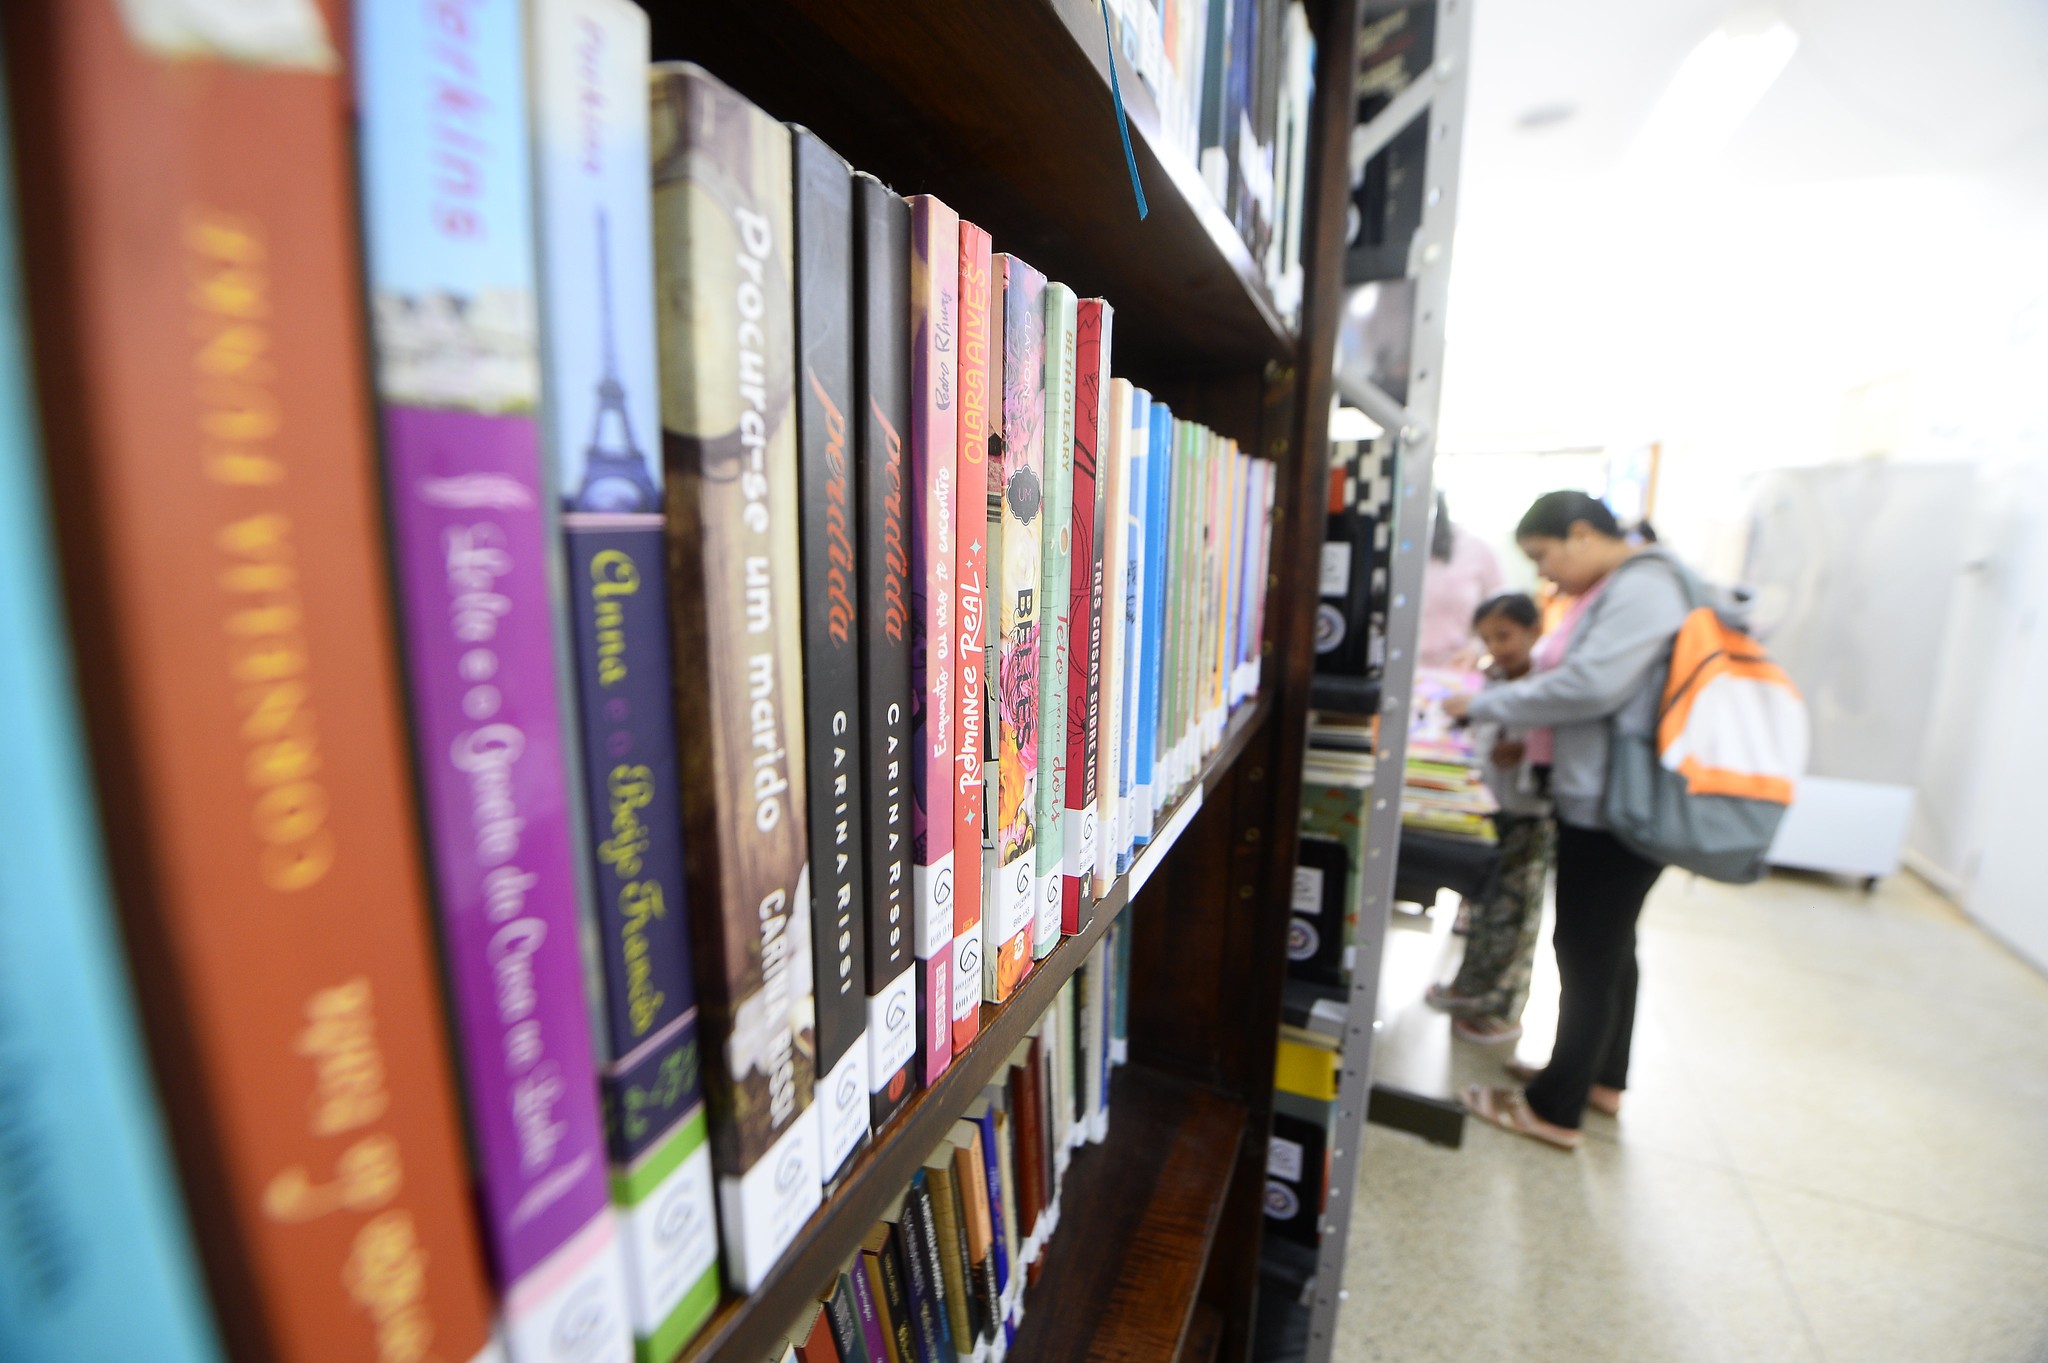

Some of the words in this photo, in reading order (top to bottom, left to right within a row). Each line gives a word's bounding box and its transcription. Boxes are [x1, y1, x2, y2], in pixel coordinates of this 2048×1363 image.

[424, 0, 492, 243] erkins
[965, 262, 986, 366] ALVES
[1023, 311, 1032, 398] CLAYTON
[1064, 329, 1073, 385] BETH
[734, 206, 772, 534] Procura-se
[935, 361, 950, 411] Pedro
[964, 368, 985, 465] CLARA
[1061, 389, 1072, 473] O'LEARY
[937, 465, 950, 553] encontro
[1018, 487, 1032, 502] UM
[745, 555, 772, 634] um
[937, 558, 949, 583] te
[937, 587, 949, 631] não
[590, 549, 641, 689] Anna
[937, 632, 949, 660] eu
[1055, 605, 1069, 685] Teto
[1090, 615, 1100, 687] COISAS
[933, 666, 949, 759] Enquanto
[1013, 588, 1033, 751] BELLES
[749, 652, 789, 833] marido
[1088, 691, 1098, 754] SOBRE
[597, 764, 656, 880] Beijo
[831, 710, 850, 875] CARINA
[886, 703, 900, 852] CARINA
[1051, 755, 1066, 832] dois
[758, 887, 791, 1028] CARINA
[836, 883, 852, 995] RISSI
[887, 859, 901, 963] RISSI
[767, 1025, 796, 1131] RISSI
